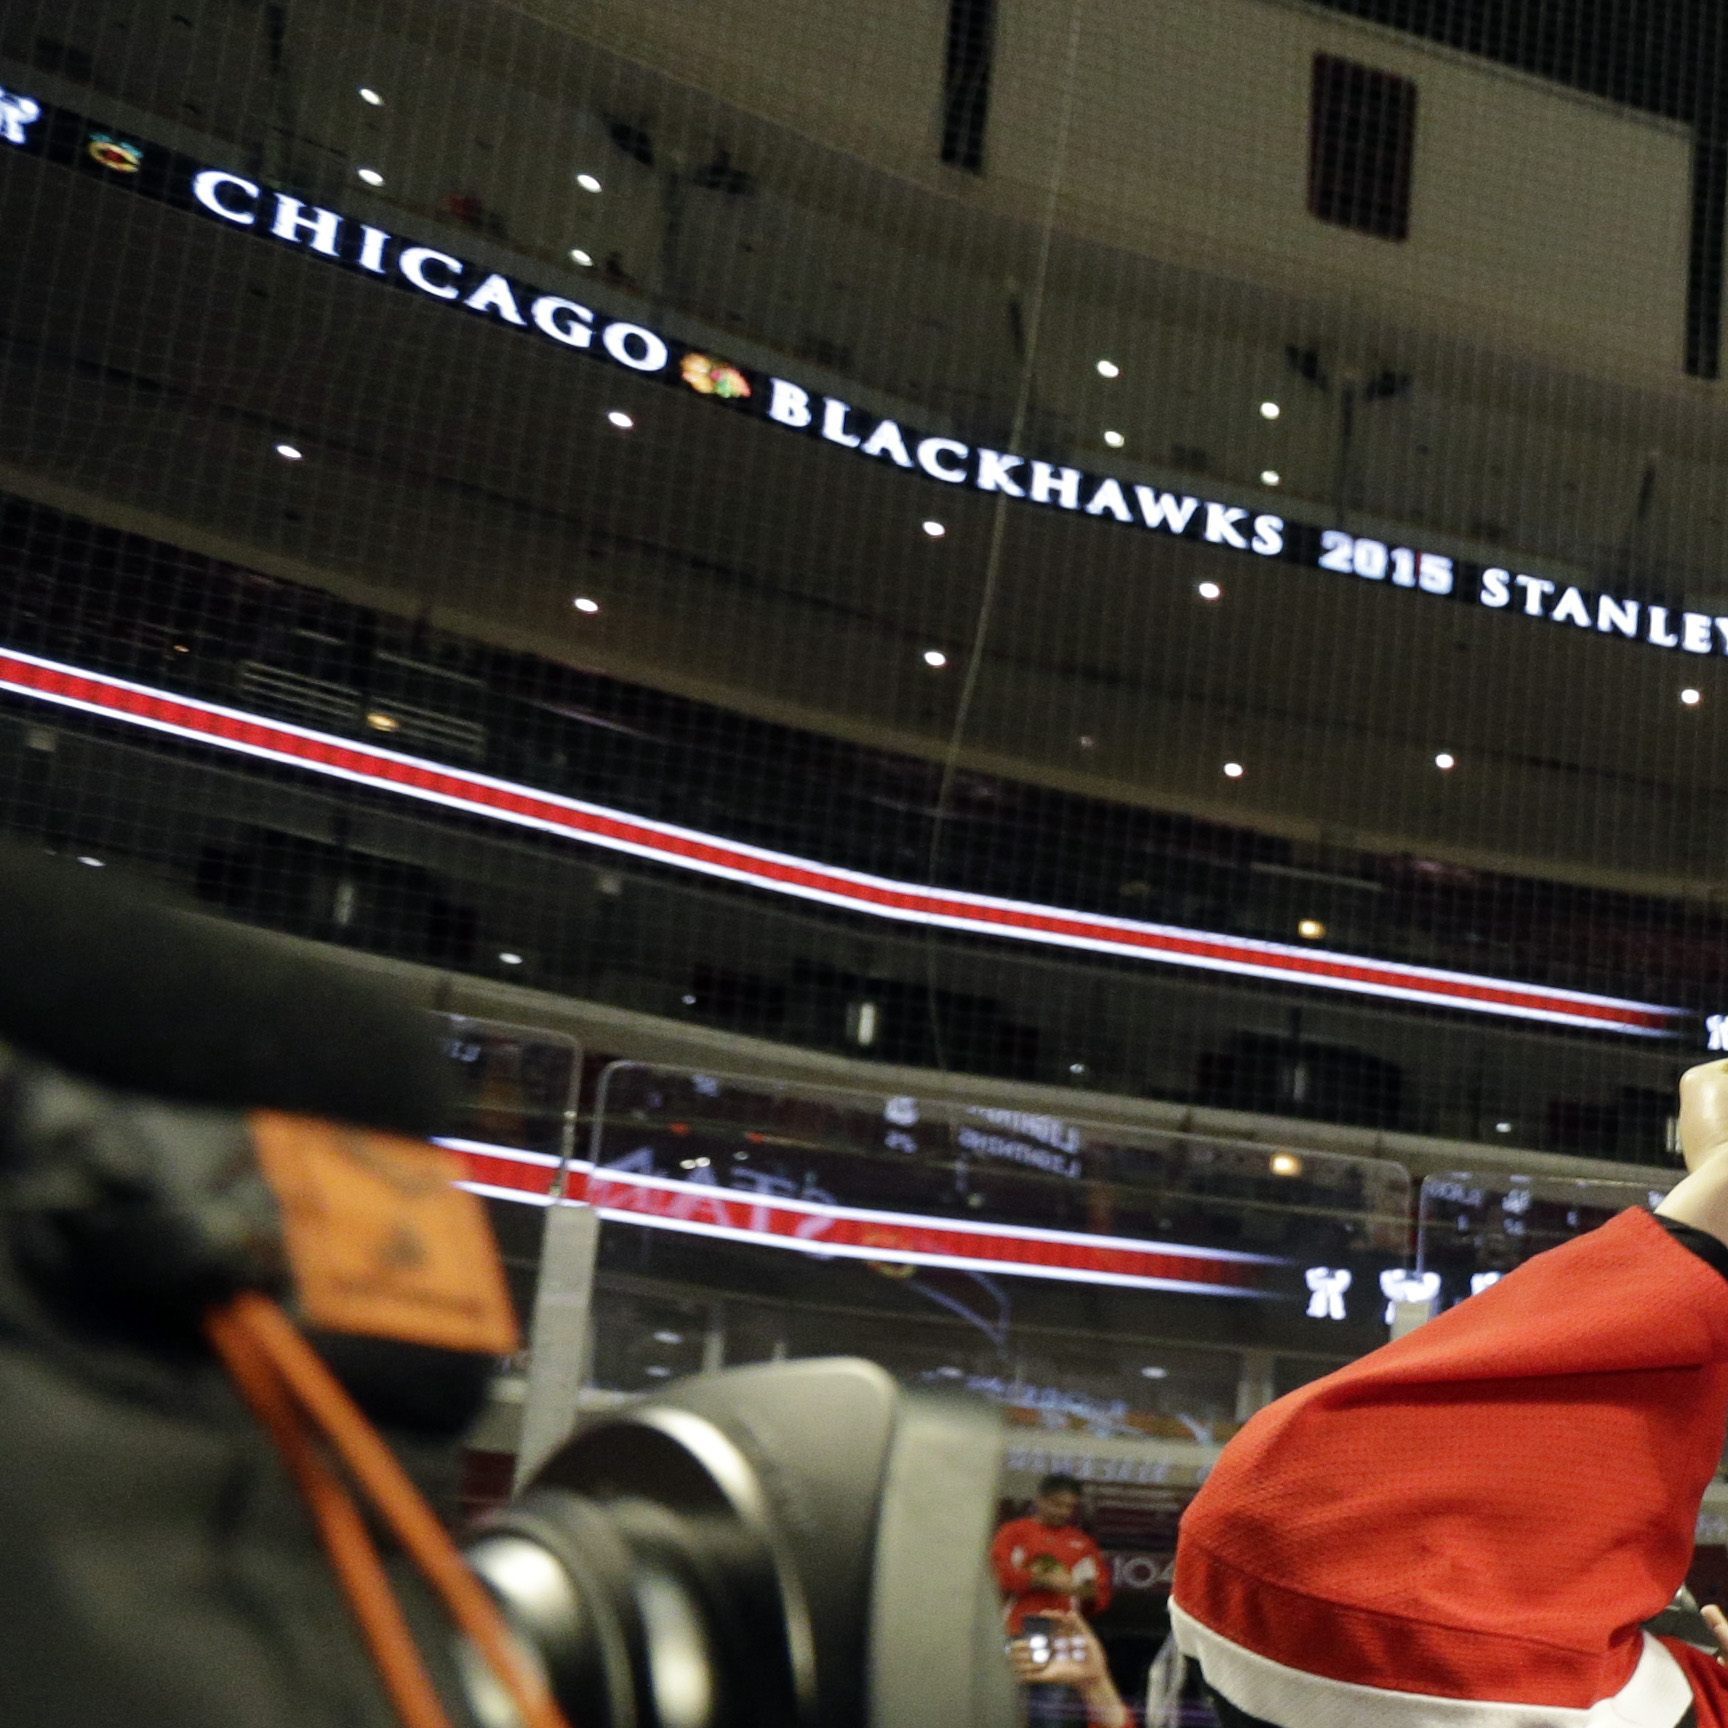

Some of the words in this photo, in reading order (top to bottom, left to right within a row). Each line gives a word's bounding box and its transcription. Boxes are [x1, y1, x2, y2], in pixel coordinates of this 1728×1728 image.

[193, 169, 668, 372] CHICAGO
[768, 378, 1285, 556] BLACKHAWKS
[1318, 530, 1454, 594] 2015
